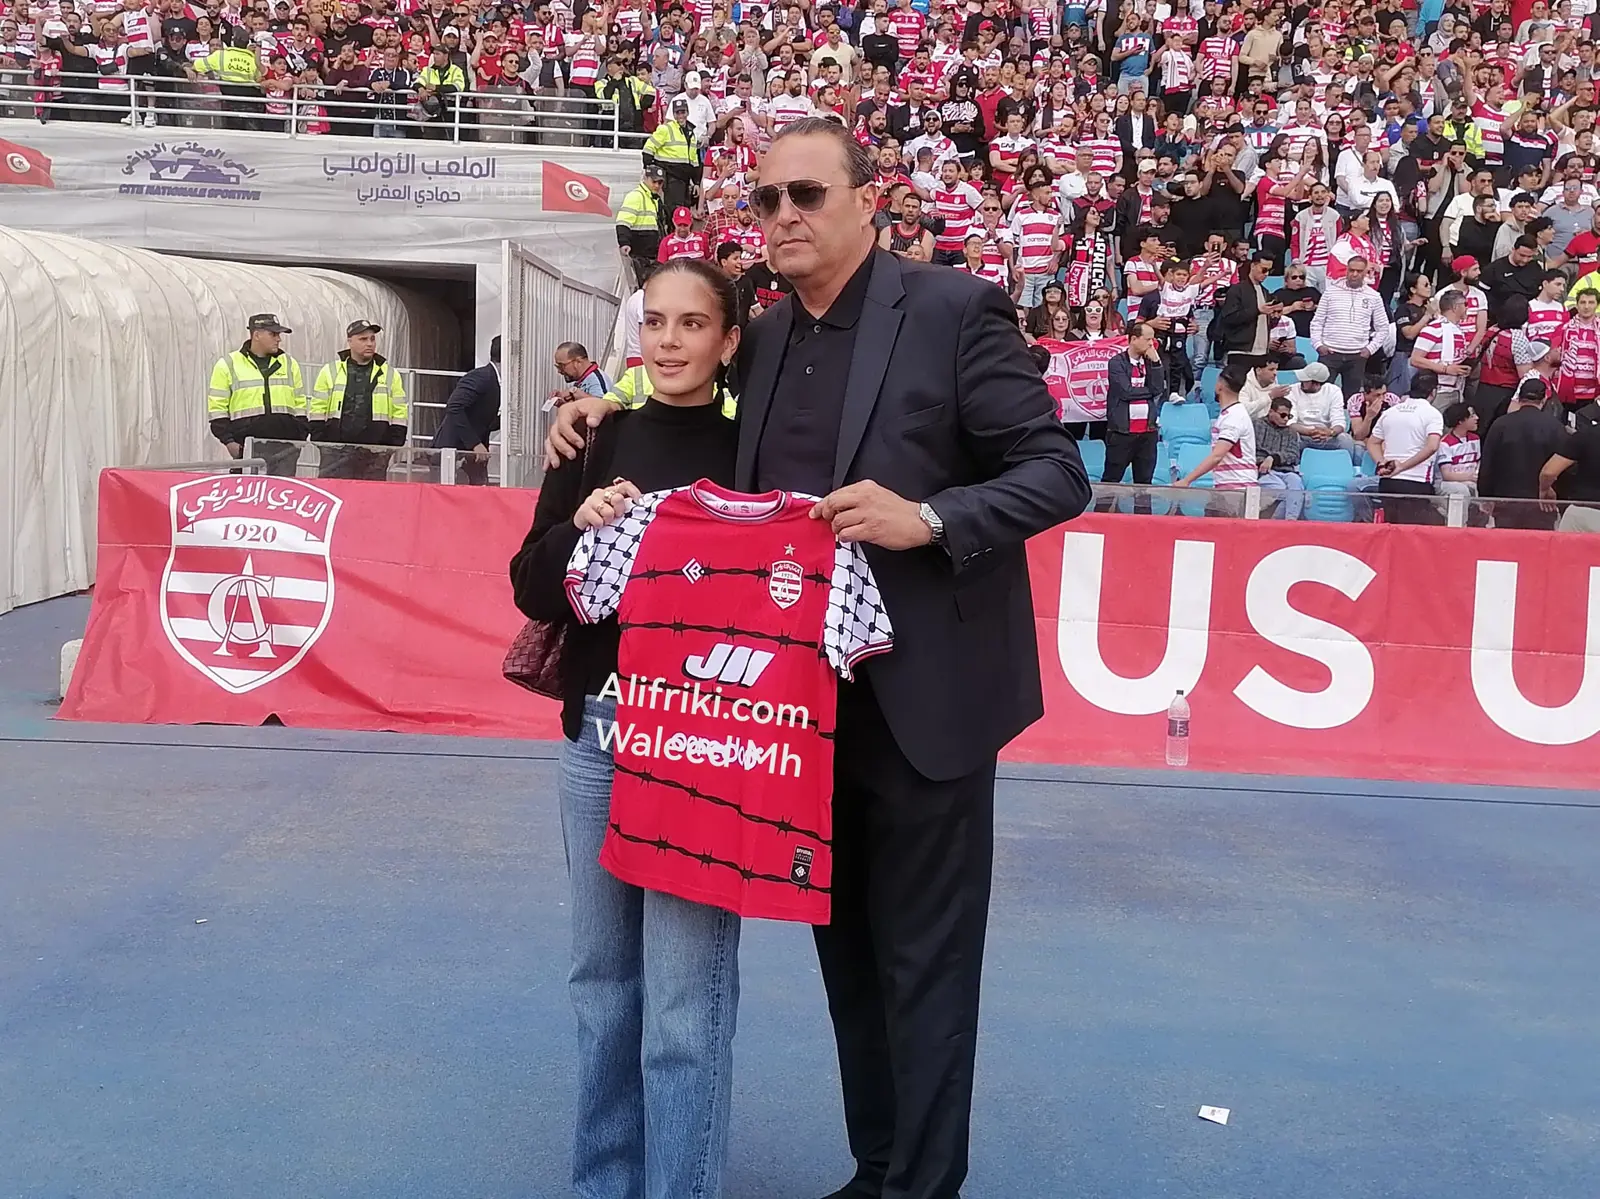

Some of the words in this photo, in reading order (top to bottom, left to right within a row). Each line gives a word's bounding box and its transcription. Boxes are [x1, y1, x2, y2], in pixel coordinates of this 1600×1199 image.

[121, 142, 167, 175] الرياضي
[323, 151, 416, 182] الأولمبي
[421, 155, 496, 181] الملعب
[118, 183, 145, 194] CITE
[145, 184, 206, 198] NATIONALE
[206, 187, 261, 201] SPORTIVE
[357, 183, 411, 206] العقربي
[414, 186, 461, 209] حمادي
[268, 486, 328, 523] النادي
[221, 523, 278, 544] 1920
[1057, 530, 1378, 730] US
[1470, 559, 1600, 747] U
